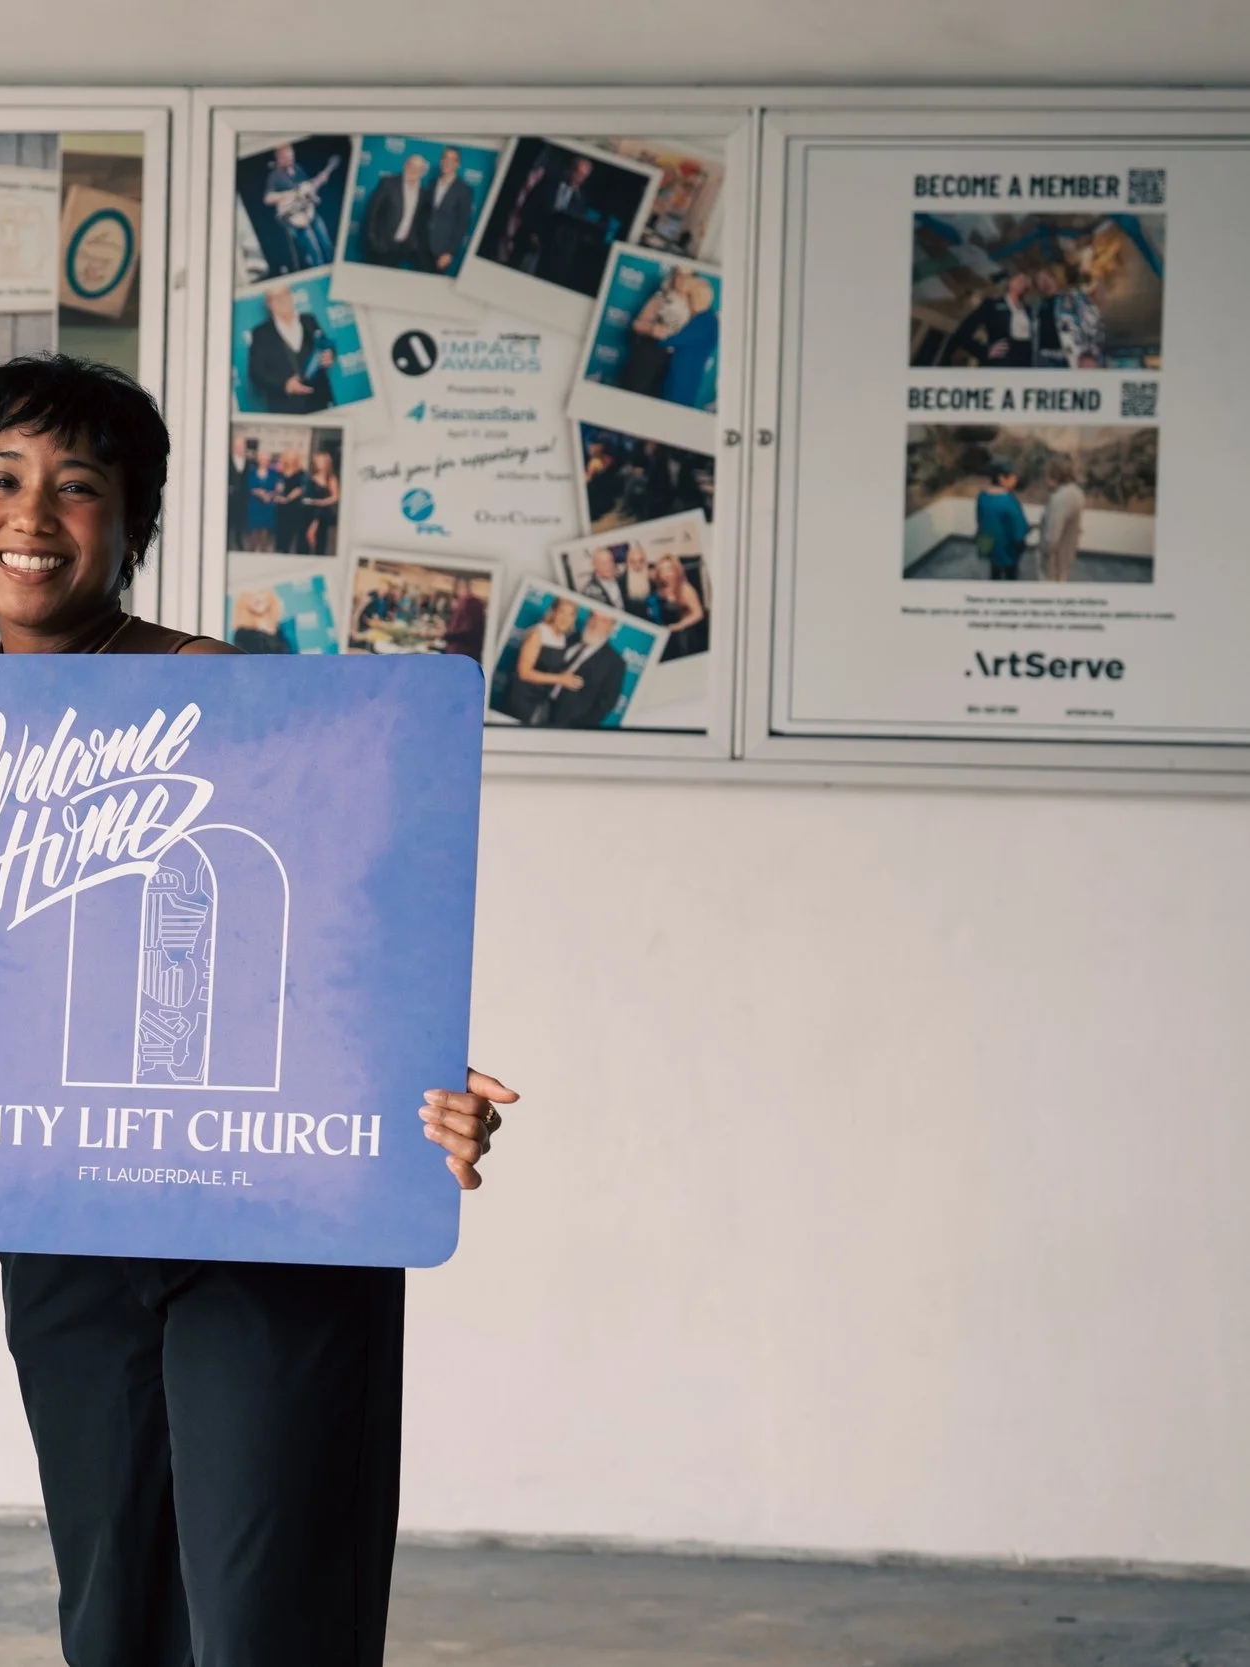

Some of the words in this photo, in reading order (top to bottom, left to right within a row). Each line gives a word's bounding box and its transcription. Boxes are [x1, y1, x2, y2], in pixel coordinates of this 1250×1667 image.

[913, 175, 1001, 198] BECOME
[1008, 175, 1022, 197] A
[1028, 175, 1120, 199] MEMBER
[439, 340, 541, 356] IMPACT
[440, 356, 542, 373] AWARDS
[907, 387, 994, 411] BECOME
[1001, 388, 1015, 411] A
[1021, 388, 1101, 412] FRIEND
[430, 404, 538, 421] SeacoastBank
[406, 464, 432, 483] you
[78, 1107, 174, 1151] LIFT
[187, 1109, 382, 1157] CHURCH
[77, 1165, 102, 1182] FT.
[106, 1167, 227, 1186] LAUDERDALE,
[231, 1170, 253, 1186] FL
